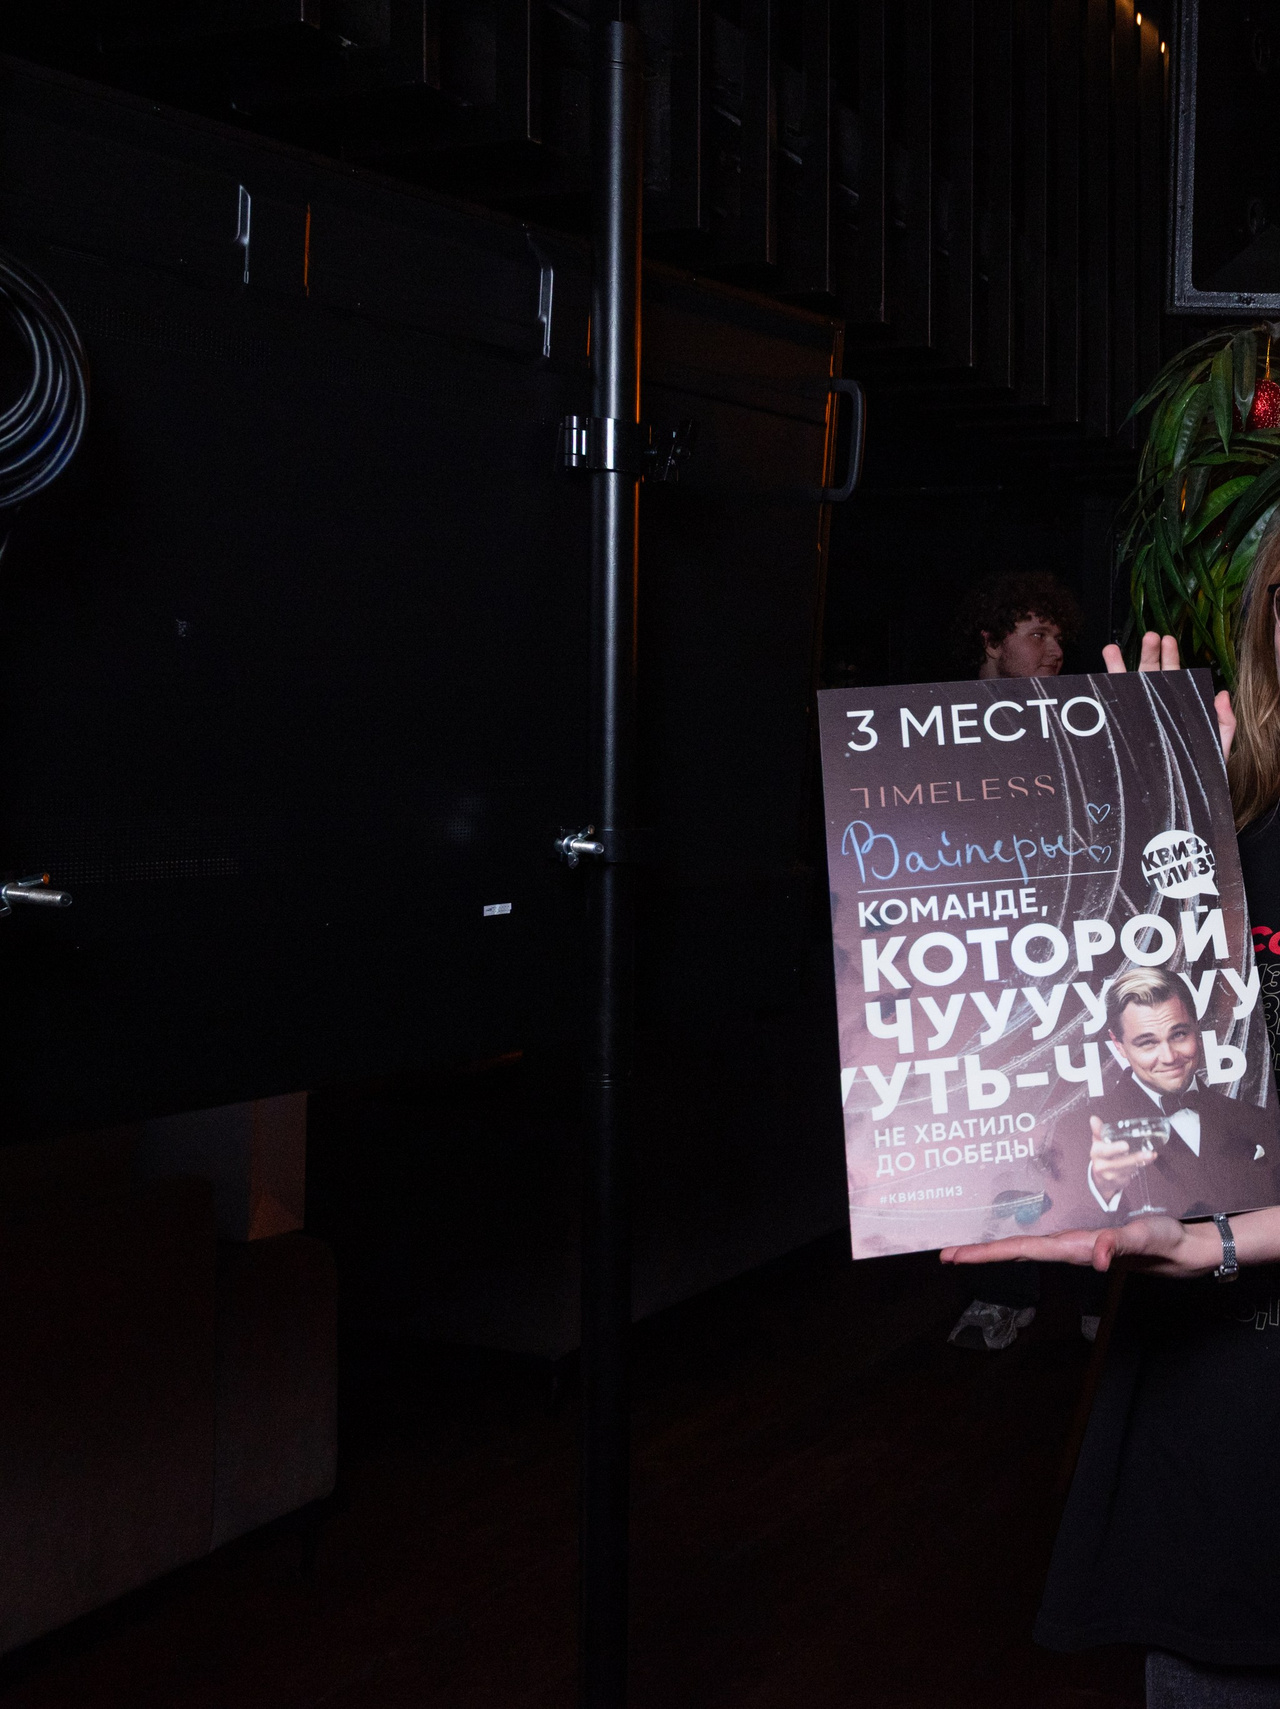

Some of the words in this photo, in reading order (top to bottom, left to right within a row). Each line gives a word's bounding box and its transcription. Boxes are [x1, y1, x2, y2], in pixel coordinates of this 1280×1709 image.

[847, 710, 878, 751] 3
[900, 696, 1106, 748] МЕСТО
[850, 775, 1055, 808] TIMELESS
[841, 820, 1080, 885] Вайперы
[1146, 854, 1217, 890] ПЛИЗ!
[857, 888, 1048, 927] КОМАНДЕ,
[860, 905, 1231, 993] КОТОРОЙ
[874, 1126, 906, 1148] НЕ
[914, 1112, 1036, 1144] ХВАТИЛО
[876, 1152, 915, 1178] ДО
[924, 1138, 1035, 1169] ПОБЕДЫ
[880, 1185, 963, 1205] #КВИЗПЛИЗ
